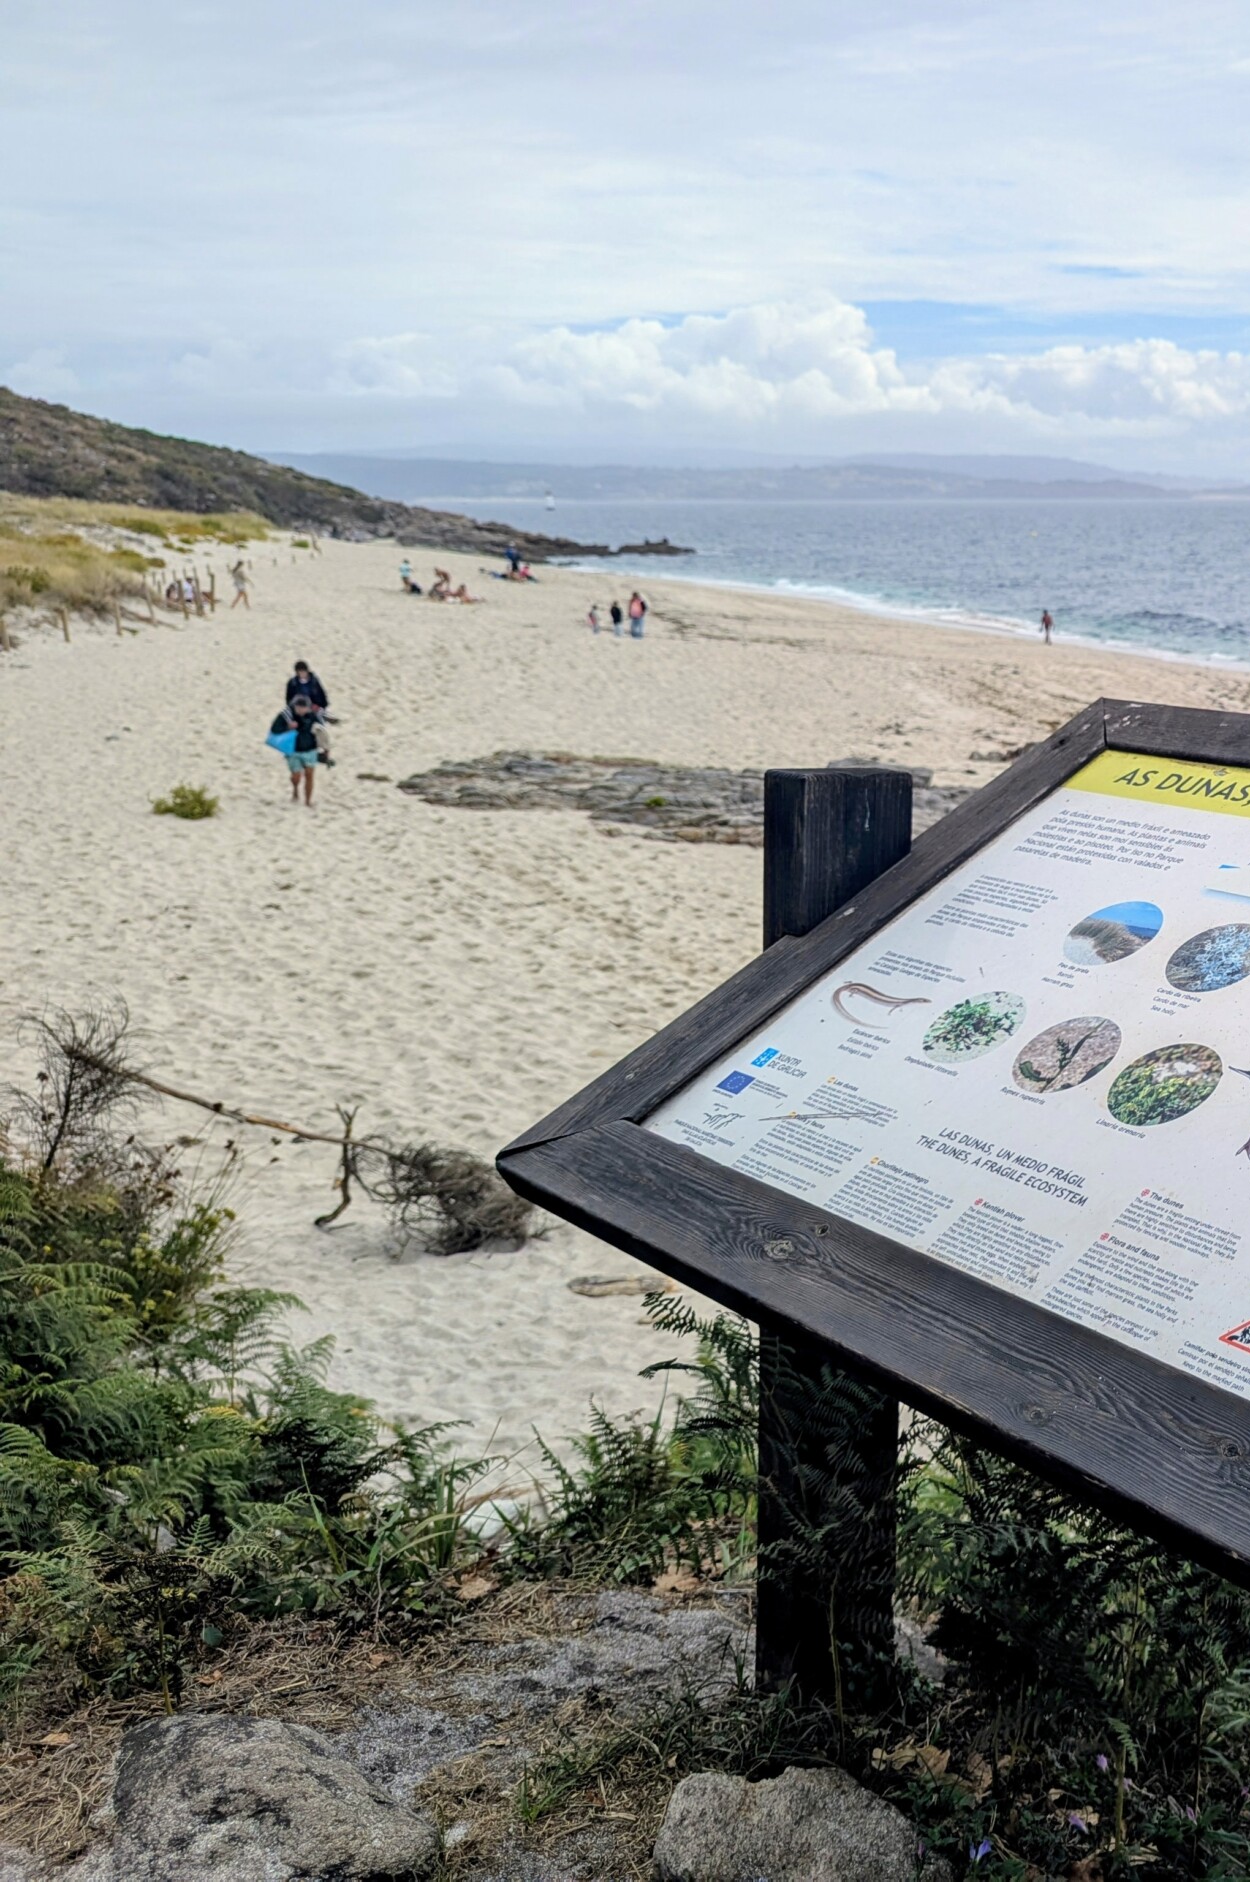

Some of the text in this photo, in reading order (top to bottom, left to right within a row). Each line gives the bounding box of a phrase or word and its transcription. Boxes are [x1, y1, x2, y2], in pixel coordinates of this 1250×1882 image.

[1112, 767, 1160, 787] AS
[766, 1059, 808, 1079] DE GALICIA
[775, 1053, 802, 1067] XUNTA
[938, 1127, 1086, 1189] LAS DUNAS, UN MEDIO FRÁGIL
[916, 1134, 1089, 1208] THE DUNES, A FRAGILE ECOSYSTEM
[1149, 1191, 1185, 1210] The dunes
[1002, 1211, 1026, 1223] plover
[1107, 1235, 1161, 1262] Flora and fauna
